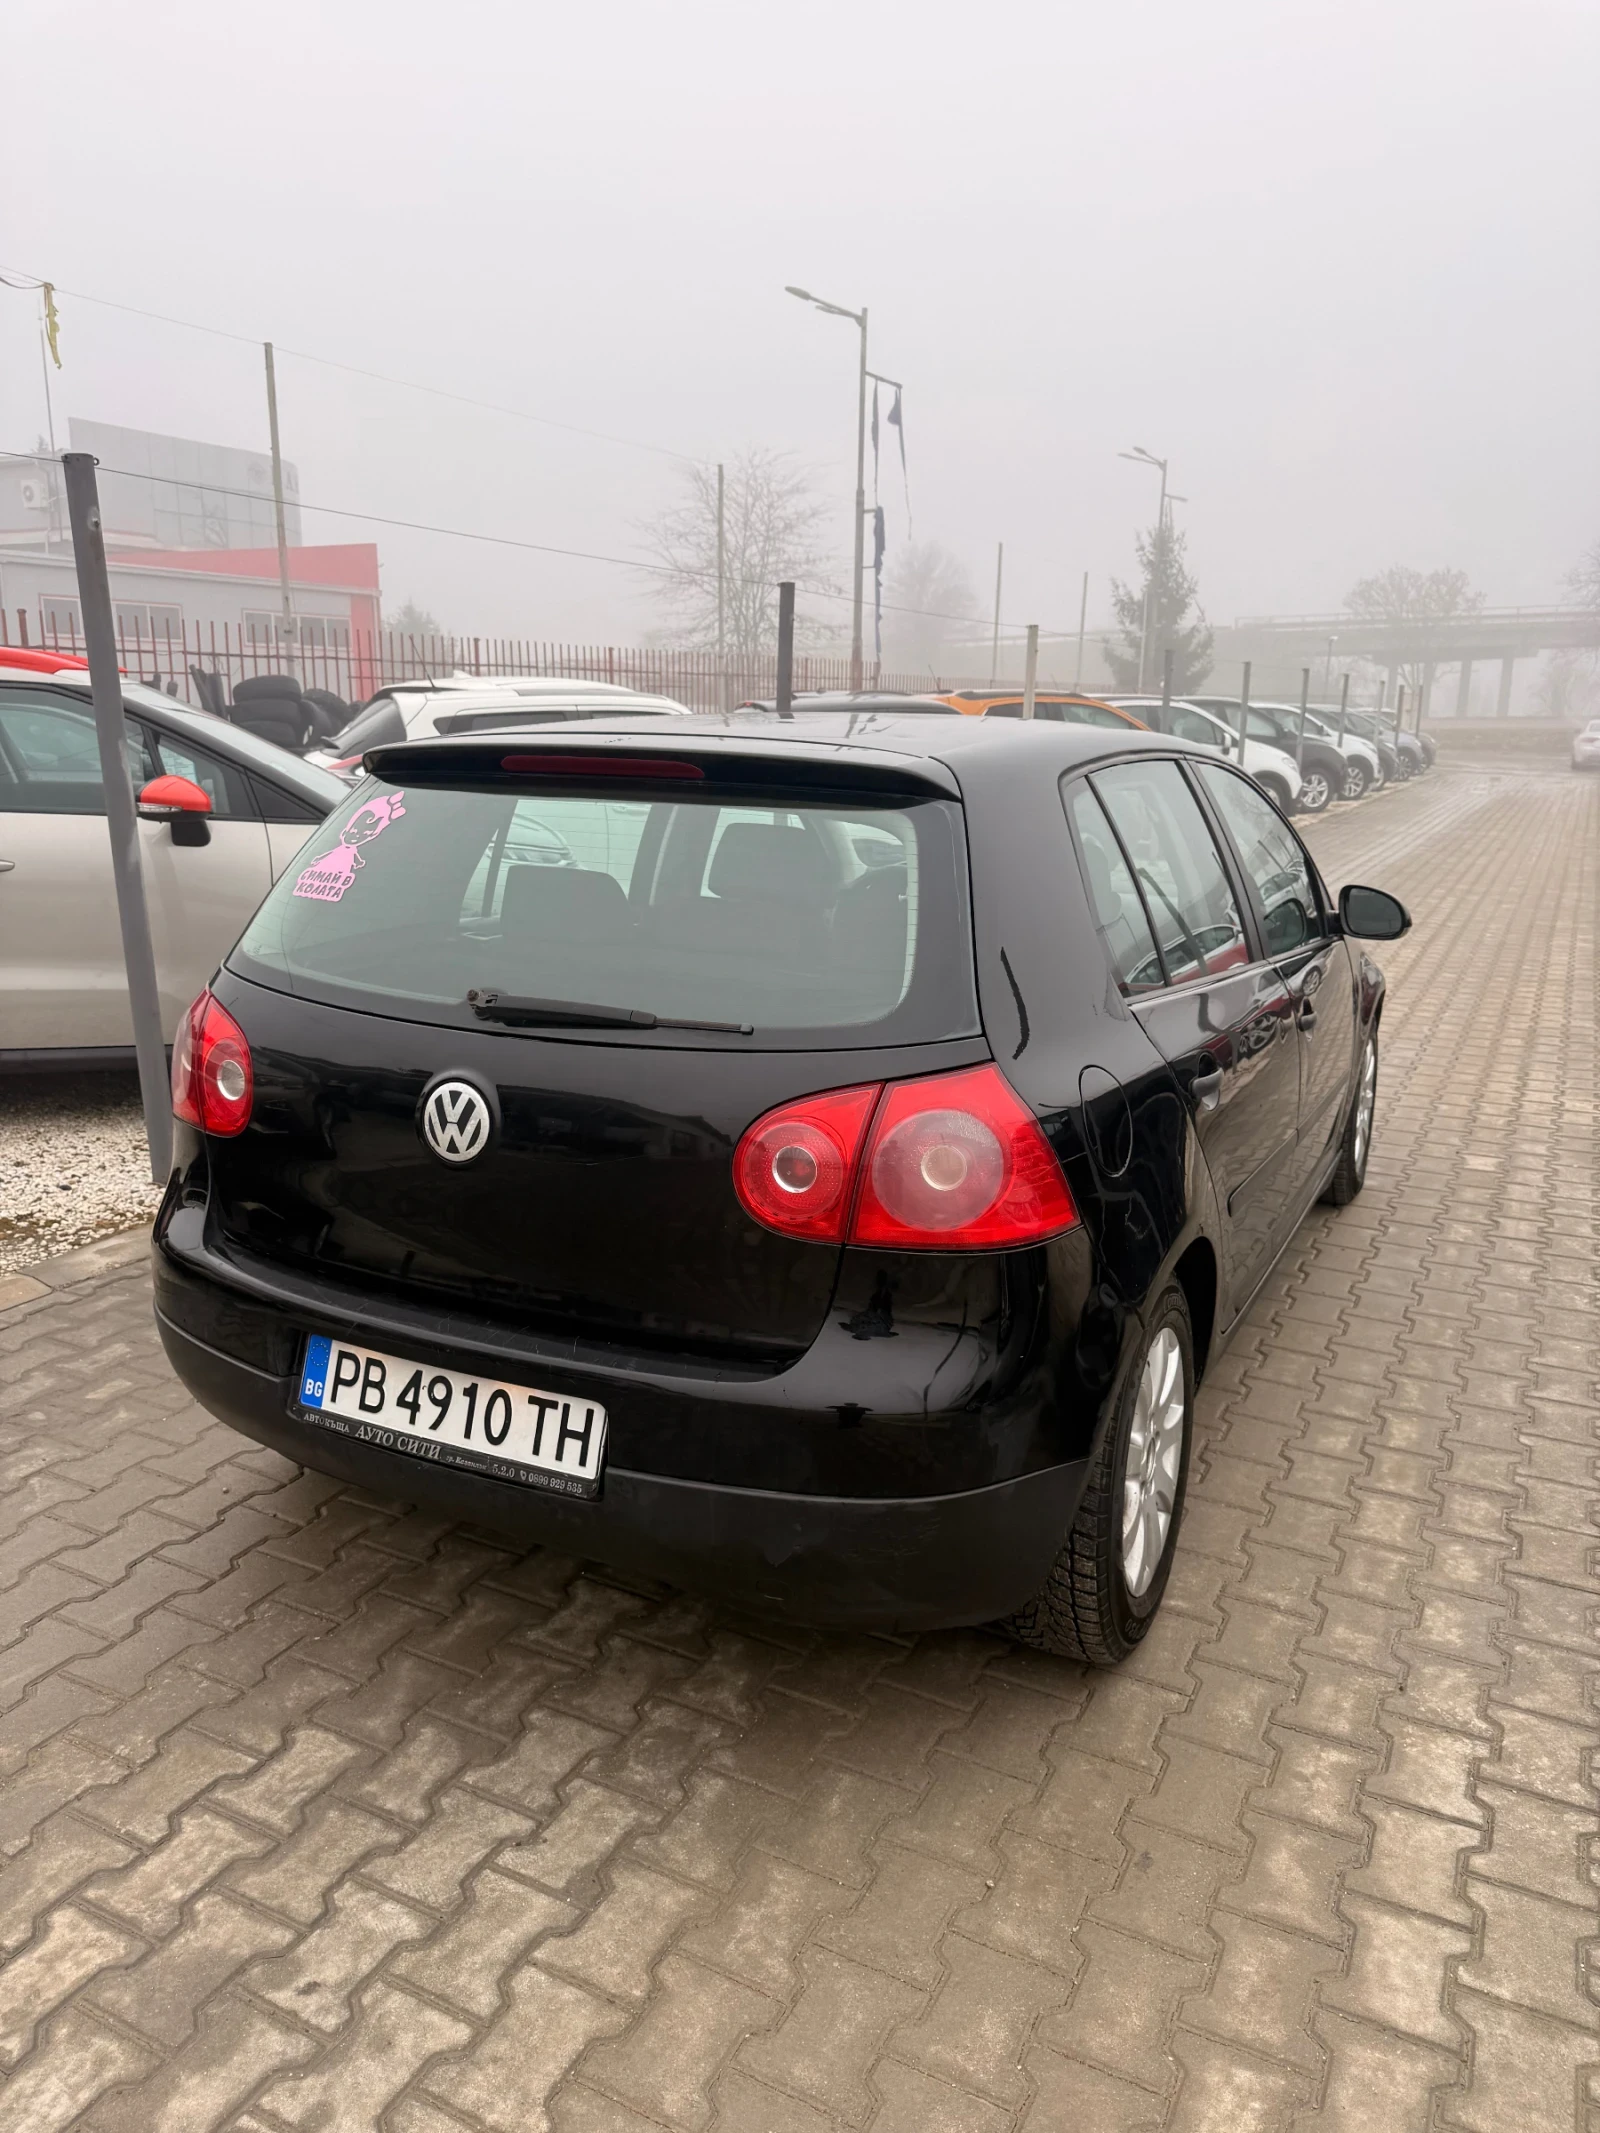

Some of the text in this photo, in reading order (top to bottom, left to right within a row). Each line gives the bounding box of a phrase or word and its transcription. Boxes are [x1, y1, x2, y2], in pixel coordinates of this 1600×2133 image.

[296, 882, 342, 898] КОЛАТА
[304, 1379, 324, 1398] BG
[330, 1349, 595, 1468] PB 4910 TH
[304, 1412, 350, 1433] АВТОКЪЩА
[355, 1425, 394, 1447] АУТО
[397, 1436, 441, 1460] СИТИ
[529, 1472, 549, 1486] 0899
[550, 1476, 566, 1490] 929
[566, 1481, 583, 1494] 535
